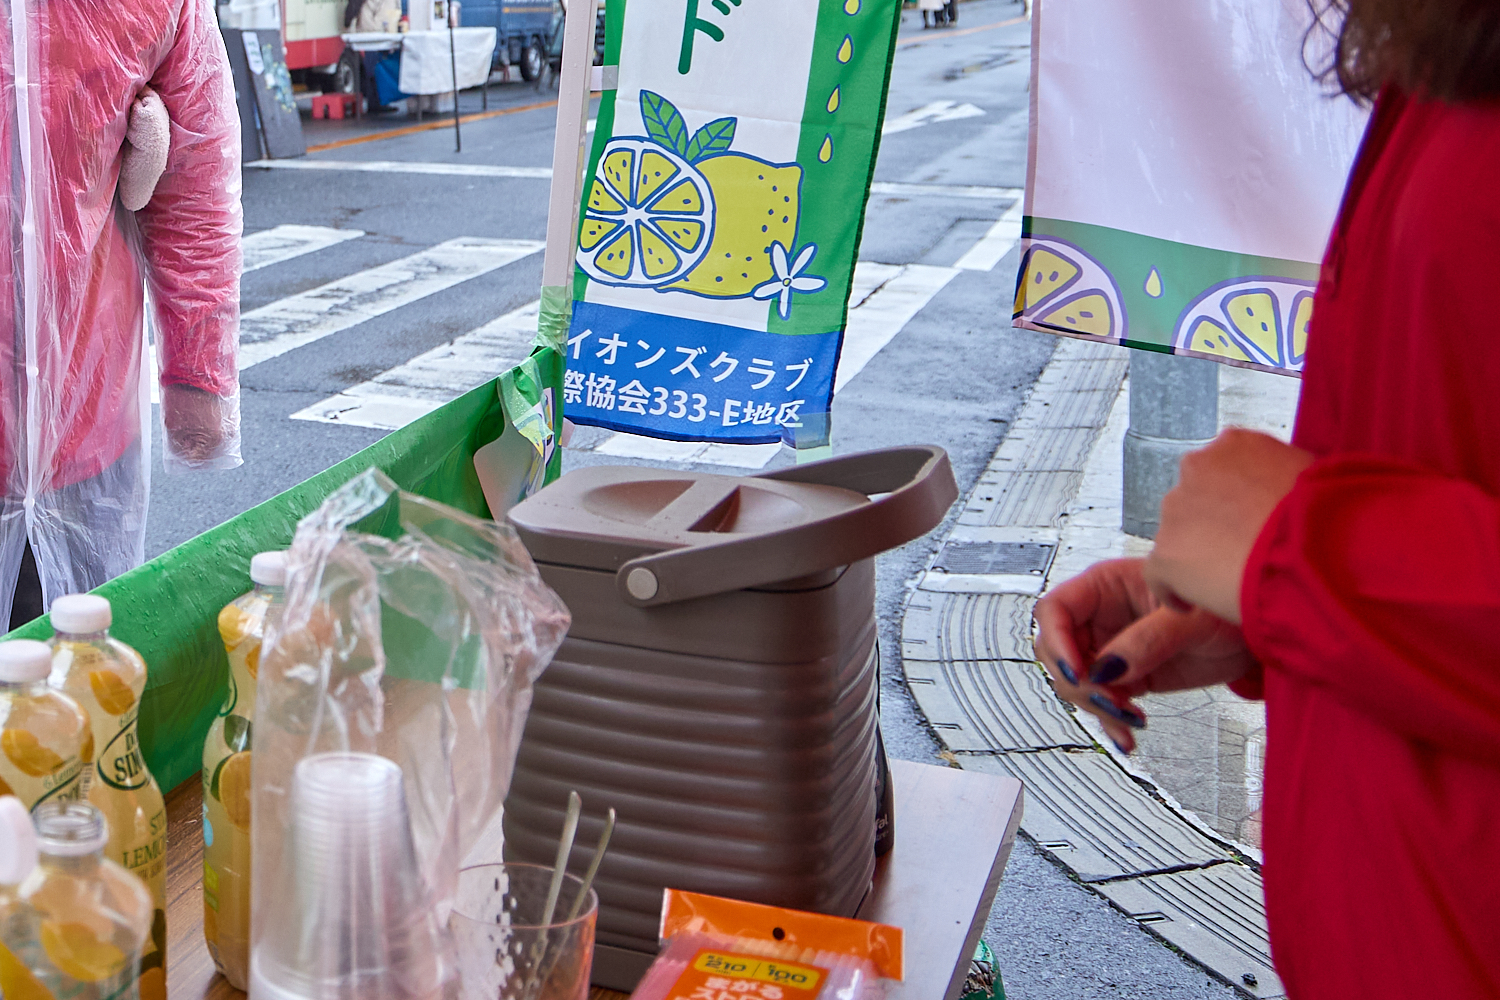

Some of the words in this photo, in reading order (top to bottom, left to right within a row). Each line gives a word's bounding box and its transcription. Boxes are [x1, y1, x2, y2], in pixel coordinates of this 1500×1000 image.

[566, 328, 814, 392] イオンズクラブ
[767, 968, 808, 983] 100
